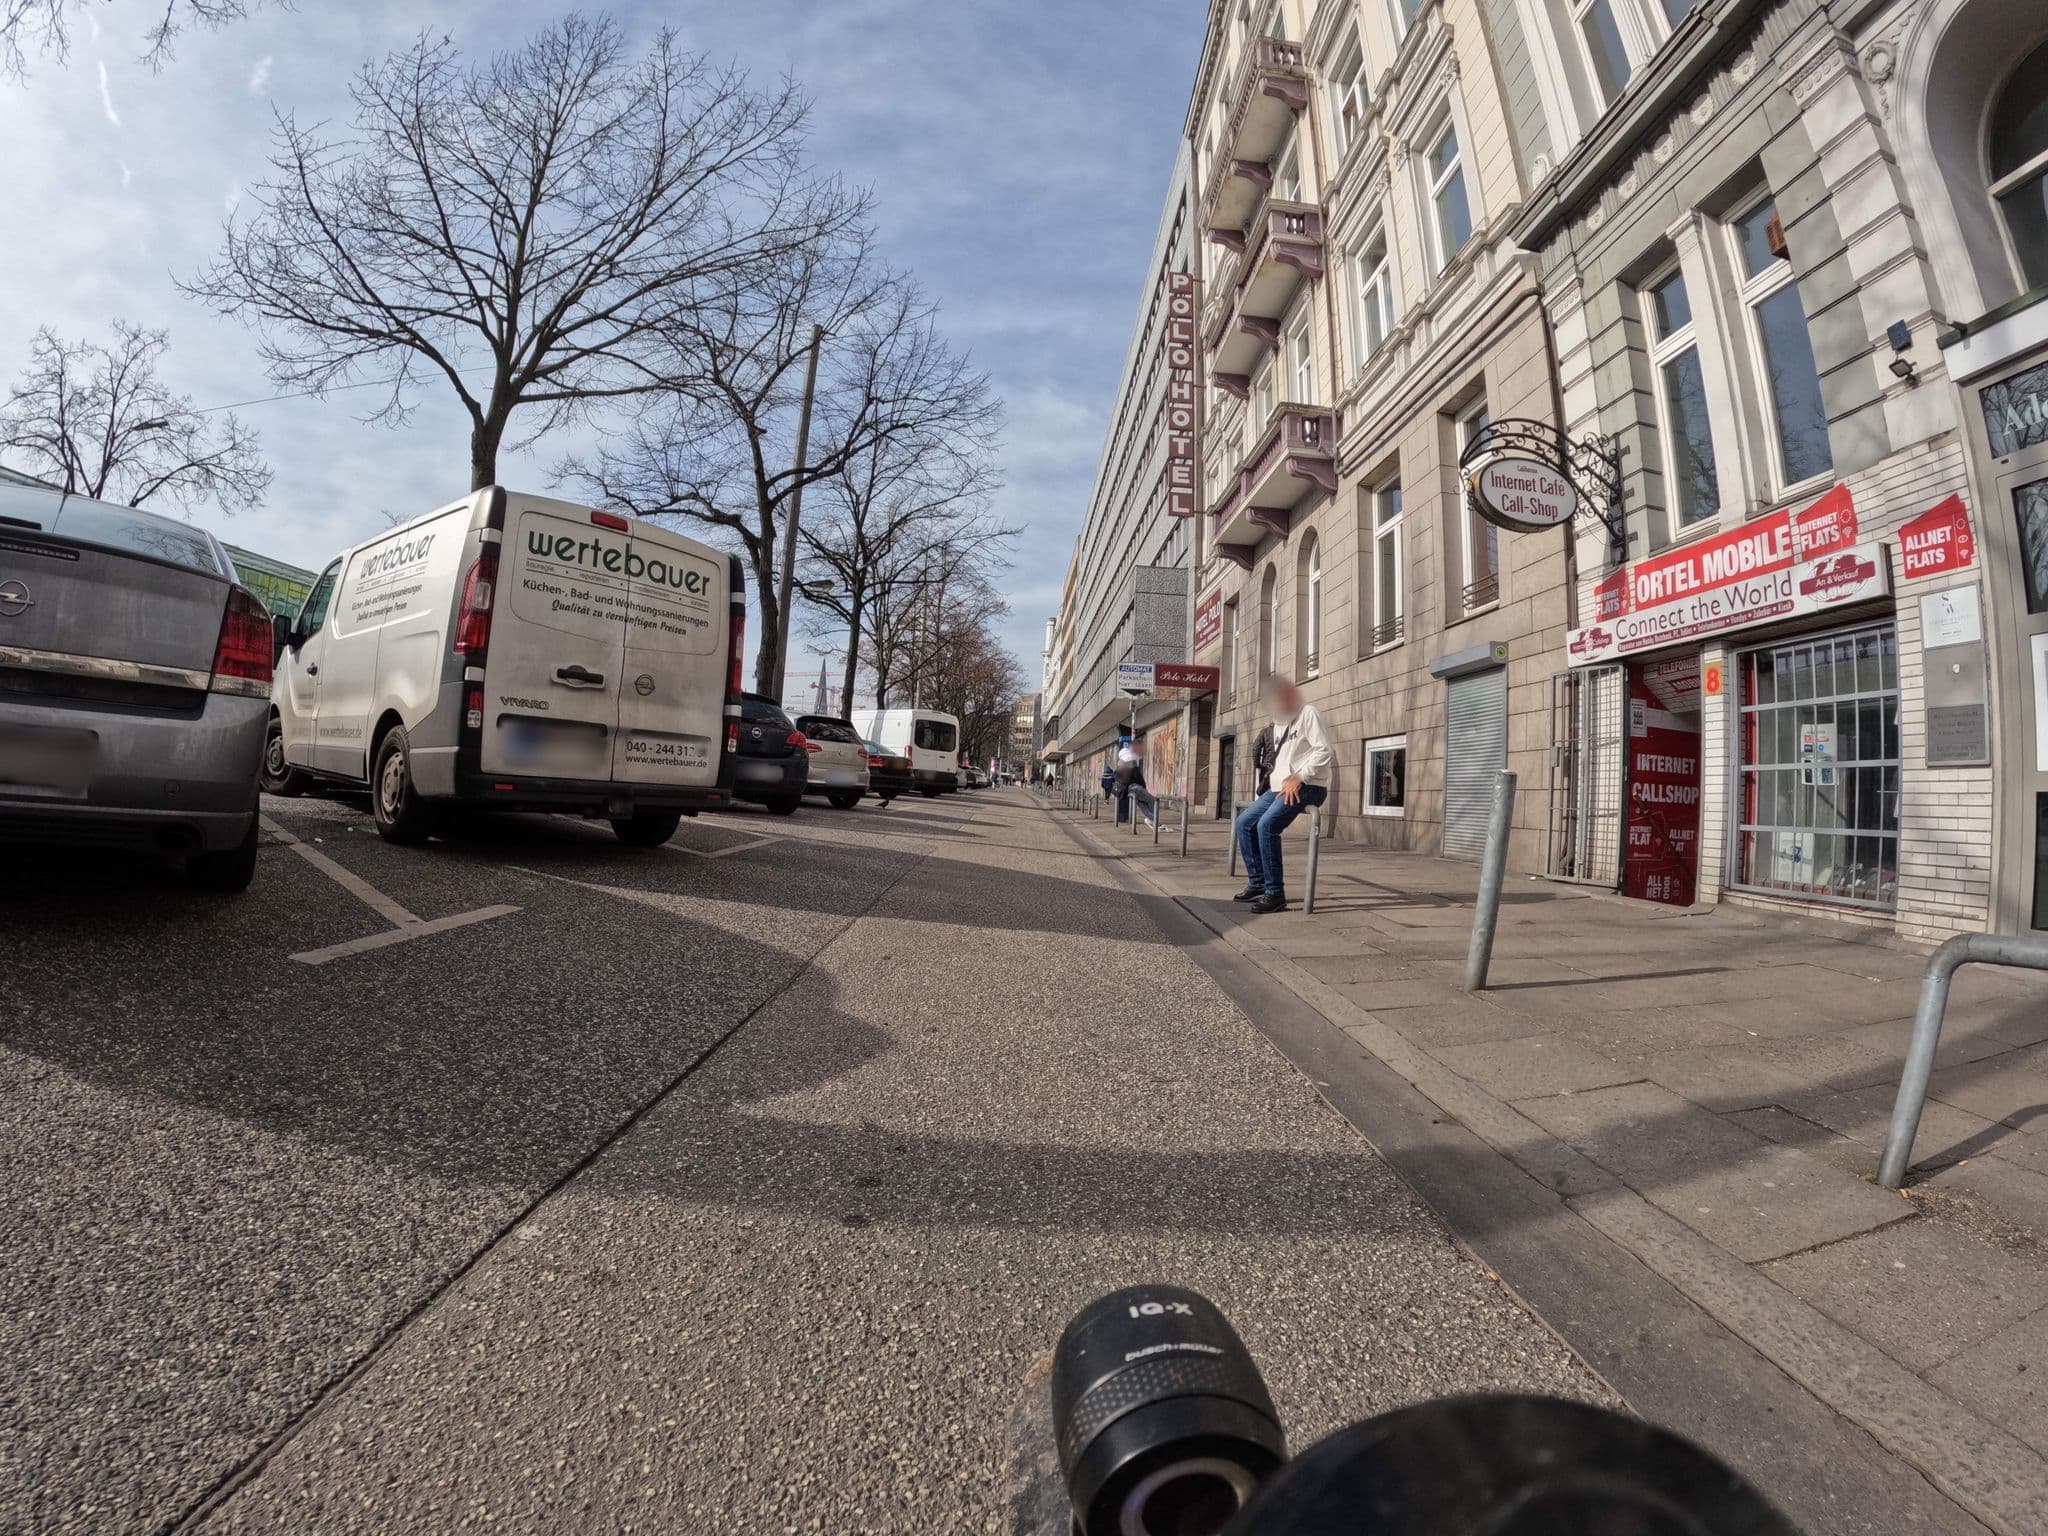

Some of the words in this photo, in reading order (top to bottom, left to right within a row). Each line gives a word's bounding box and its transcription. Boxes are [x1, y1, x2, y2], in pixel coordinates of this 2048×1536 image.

[1171, 274, 1190, 365] POLO
[1171, 382, 1191, 513] HOTEL
[1490, 470, 1537, 492] Internet
[1540, 476, 1565, 496] Café
[1501, 493, 1558, 521] Call-Shop
[1800, 512, 1838, 534] INTERNET
[1801, 525, 1840, 552] FLATS
[1904, 525, 1952, 552] ALLNET
[360, 534, 436, 580] wertebauer
[527, 530, 711, 597] wertebauer
[1636, 559, 1701, 603] ORTEL
[1702, 524, 1793, 585] MOBILE
[1906, 547, 1946, 571] FLATS
[1816, 578, 1826, 587] An
[1833, 568, 1859, 583] Verkauf
[523, 579, 568, 597] Küchen-,
[570, 588, 592, 600] Bad-
[594, 594, 613, 606] und
[615, 597, 709, 628] Wohnungssanierungen
[1596, 601, 1620, 617] FLATS
[1616, 607, 1685, 640] Connect
[1691, 597, 1721, 621] the
[1724, 570, 1793, 609] World
[551, 599, 590, 616] Qualität
[592, 609, 602, 617] zu
[660, 621, 687, 636] Preisen
[1120, 665, 1152, 673] AUTOMAT
[1183, 672, 1211, 683] Hotel
[1706, 667, 1720, 693] 8
[499, 695, 549, 710] VIVARO
[626, 740, 647, 753] 040
[655, 743, 674, 755] 244
[625, 755, 708, 768] www.wertebauer.de
[1637, 753, 1696, 775] INTERNET
[1632, 782, 1699, 805] CALLSHOP
[1629, 833, 1652, 846] FLAT
[1669, 828, 1695, 841] ALLNET
[1647, 875, 1662, 887] ALL
[1646, 887, 1662, 899] NET
[1129, 1302, 1194, 1319] IQ-X
